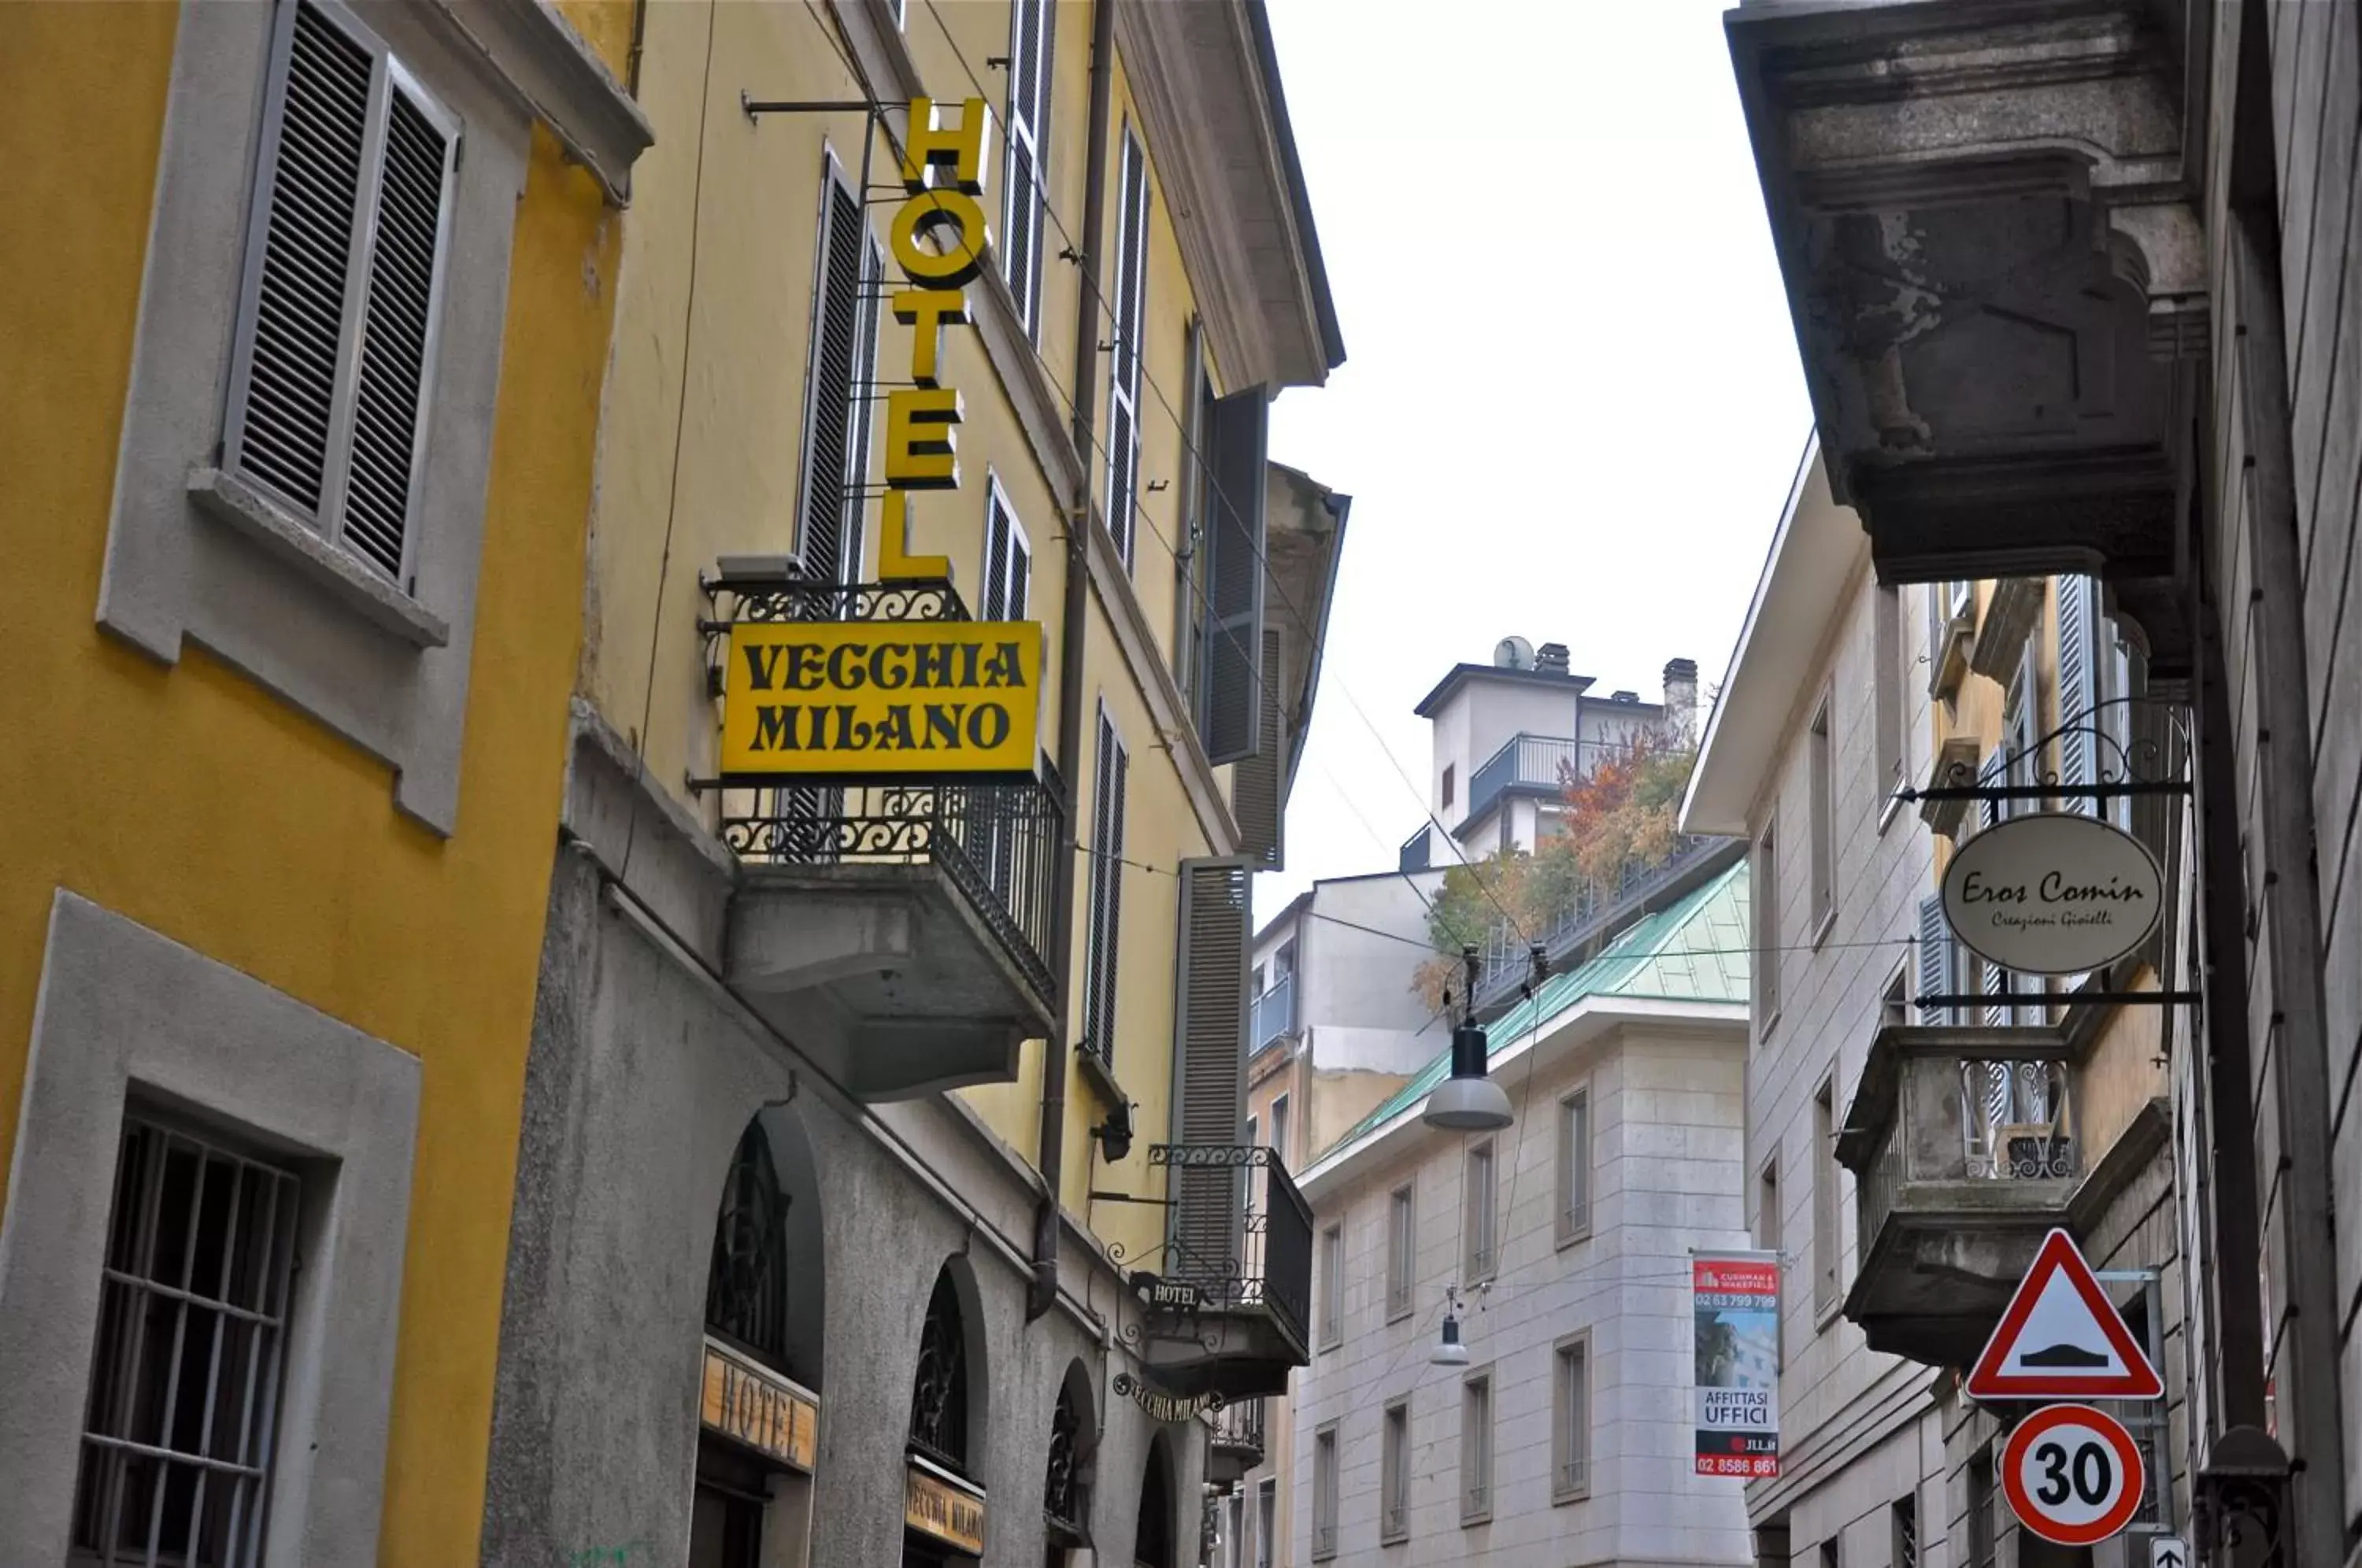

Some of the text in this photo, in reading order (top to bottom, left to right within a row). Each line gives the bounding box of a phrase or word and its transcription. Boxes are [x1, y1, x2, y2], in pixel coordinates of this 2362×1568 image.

[879, 97, 994, 583] HOTEL
[742, 641, 1027, 692] VECCHIA
[749, 701, 1013, 753] MILANO
[1962, 871, 2144, 904] Eros Comin
[1992, 910, 2112, 931] Creazioni Gioielli
[1154, 1284, 1196, 1306] HOTEL
[1695, 1294, 1710, 1306] 02
[1730, 1295, 1752, 1307] 799
[1705, 1391, 1768, 1405] AFFITTASI
[720, 1363, 800, 1463] HOTEL
[1705, 1407, 1767, 1424] UFFICI
[1697, 1458, 1714, 1472] 02
[1753, 1460, 1776, 1474] 861
[2035, 1442, 2112, 1506] 30
